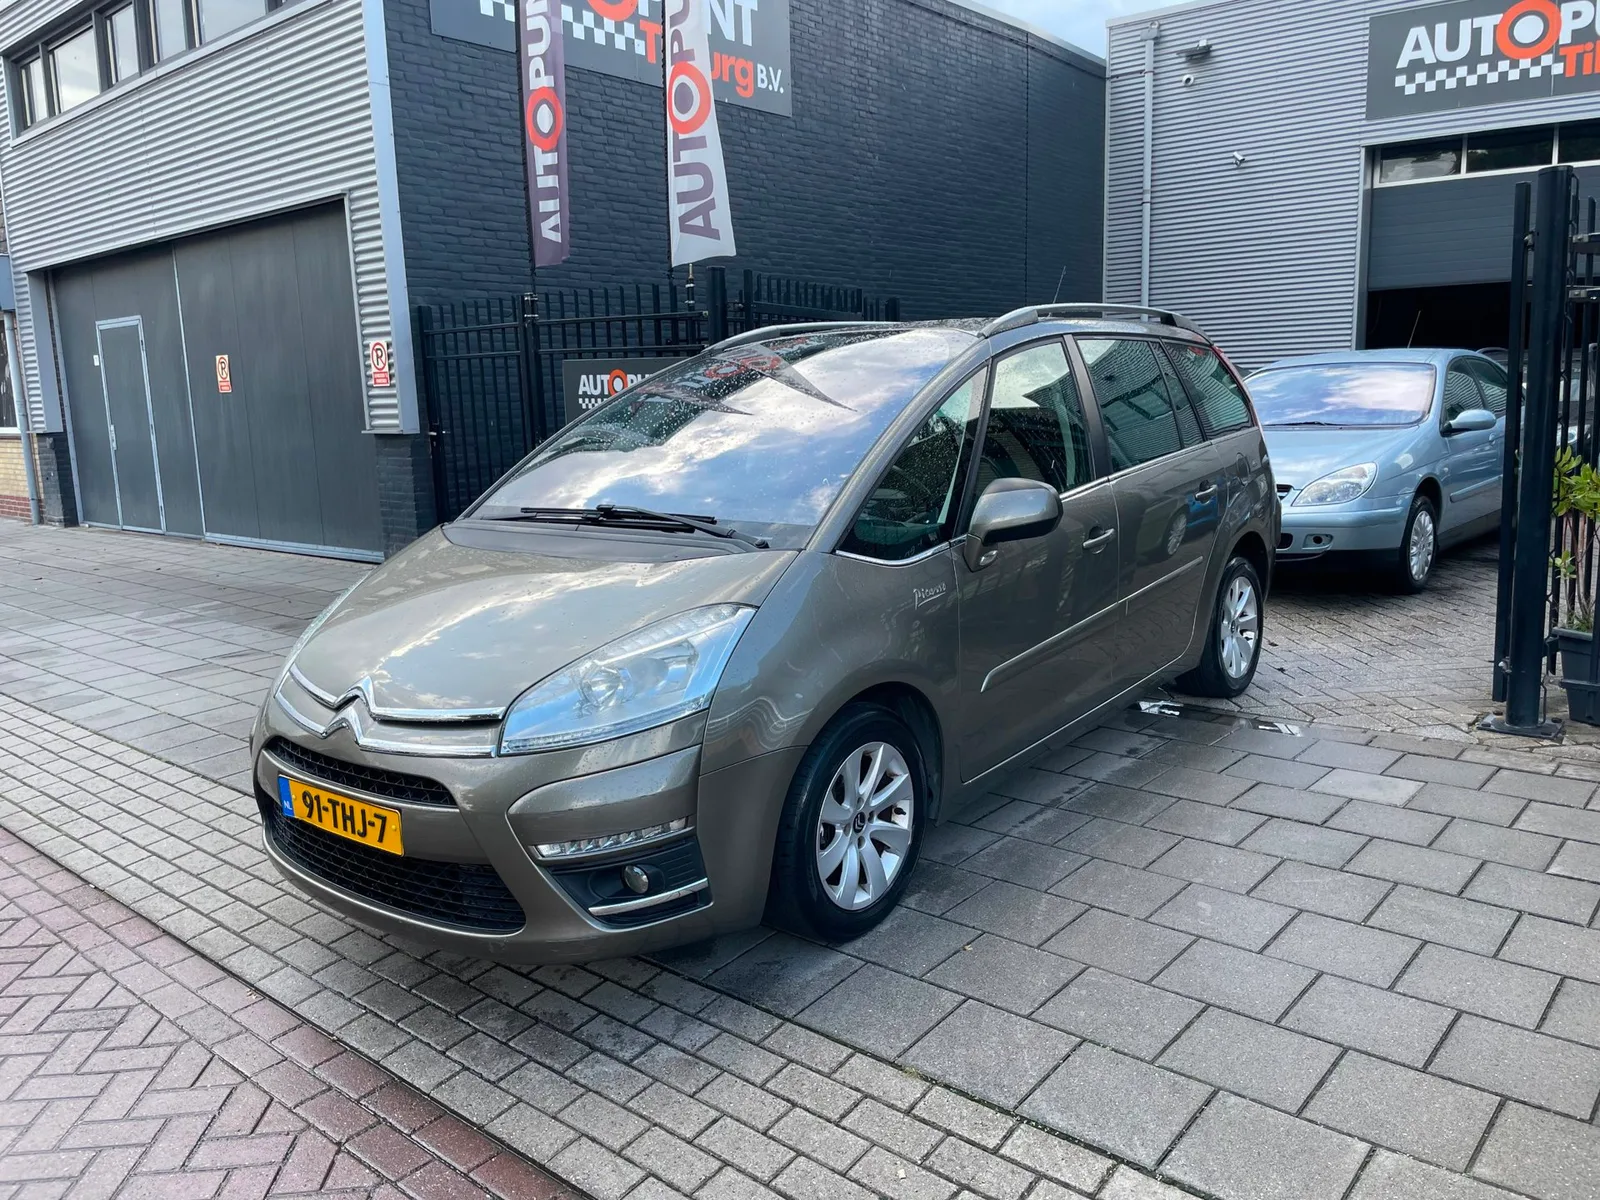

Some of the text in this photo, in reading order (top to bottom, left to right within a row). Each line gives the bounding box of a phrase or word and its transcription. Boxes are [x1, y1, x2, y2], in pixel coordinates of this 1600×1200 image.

[1396, 0, 1600, 69] AUTOP
[757, 64, 784, 94] B.V.
[578, 368, 653, 396] AUTOP
[283, 800, 293, 810] NL
[302, 790, 387, 843] 91-THJ-7
